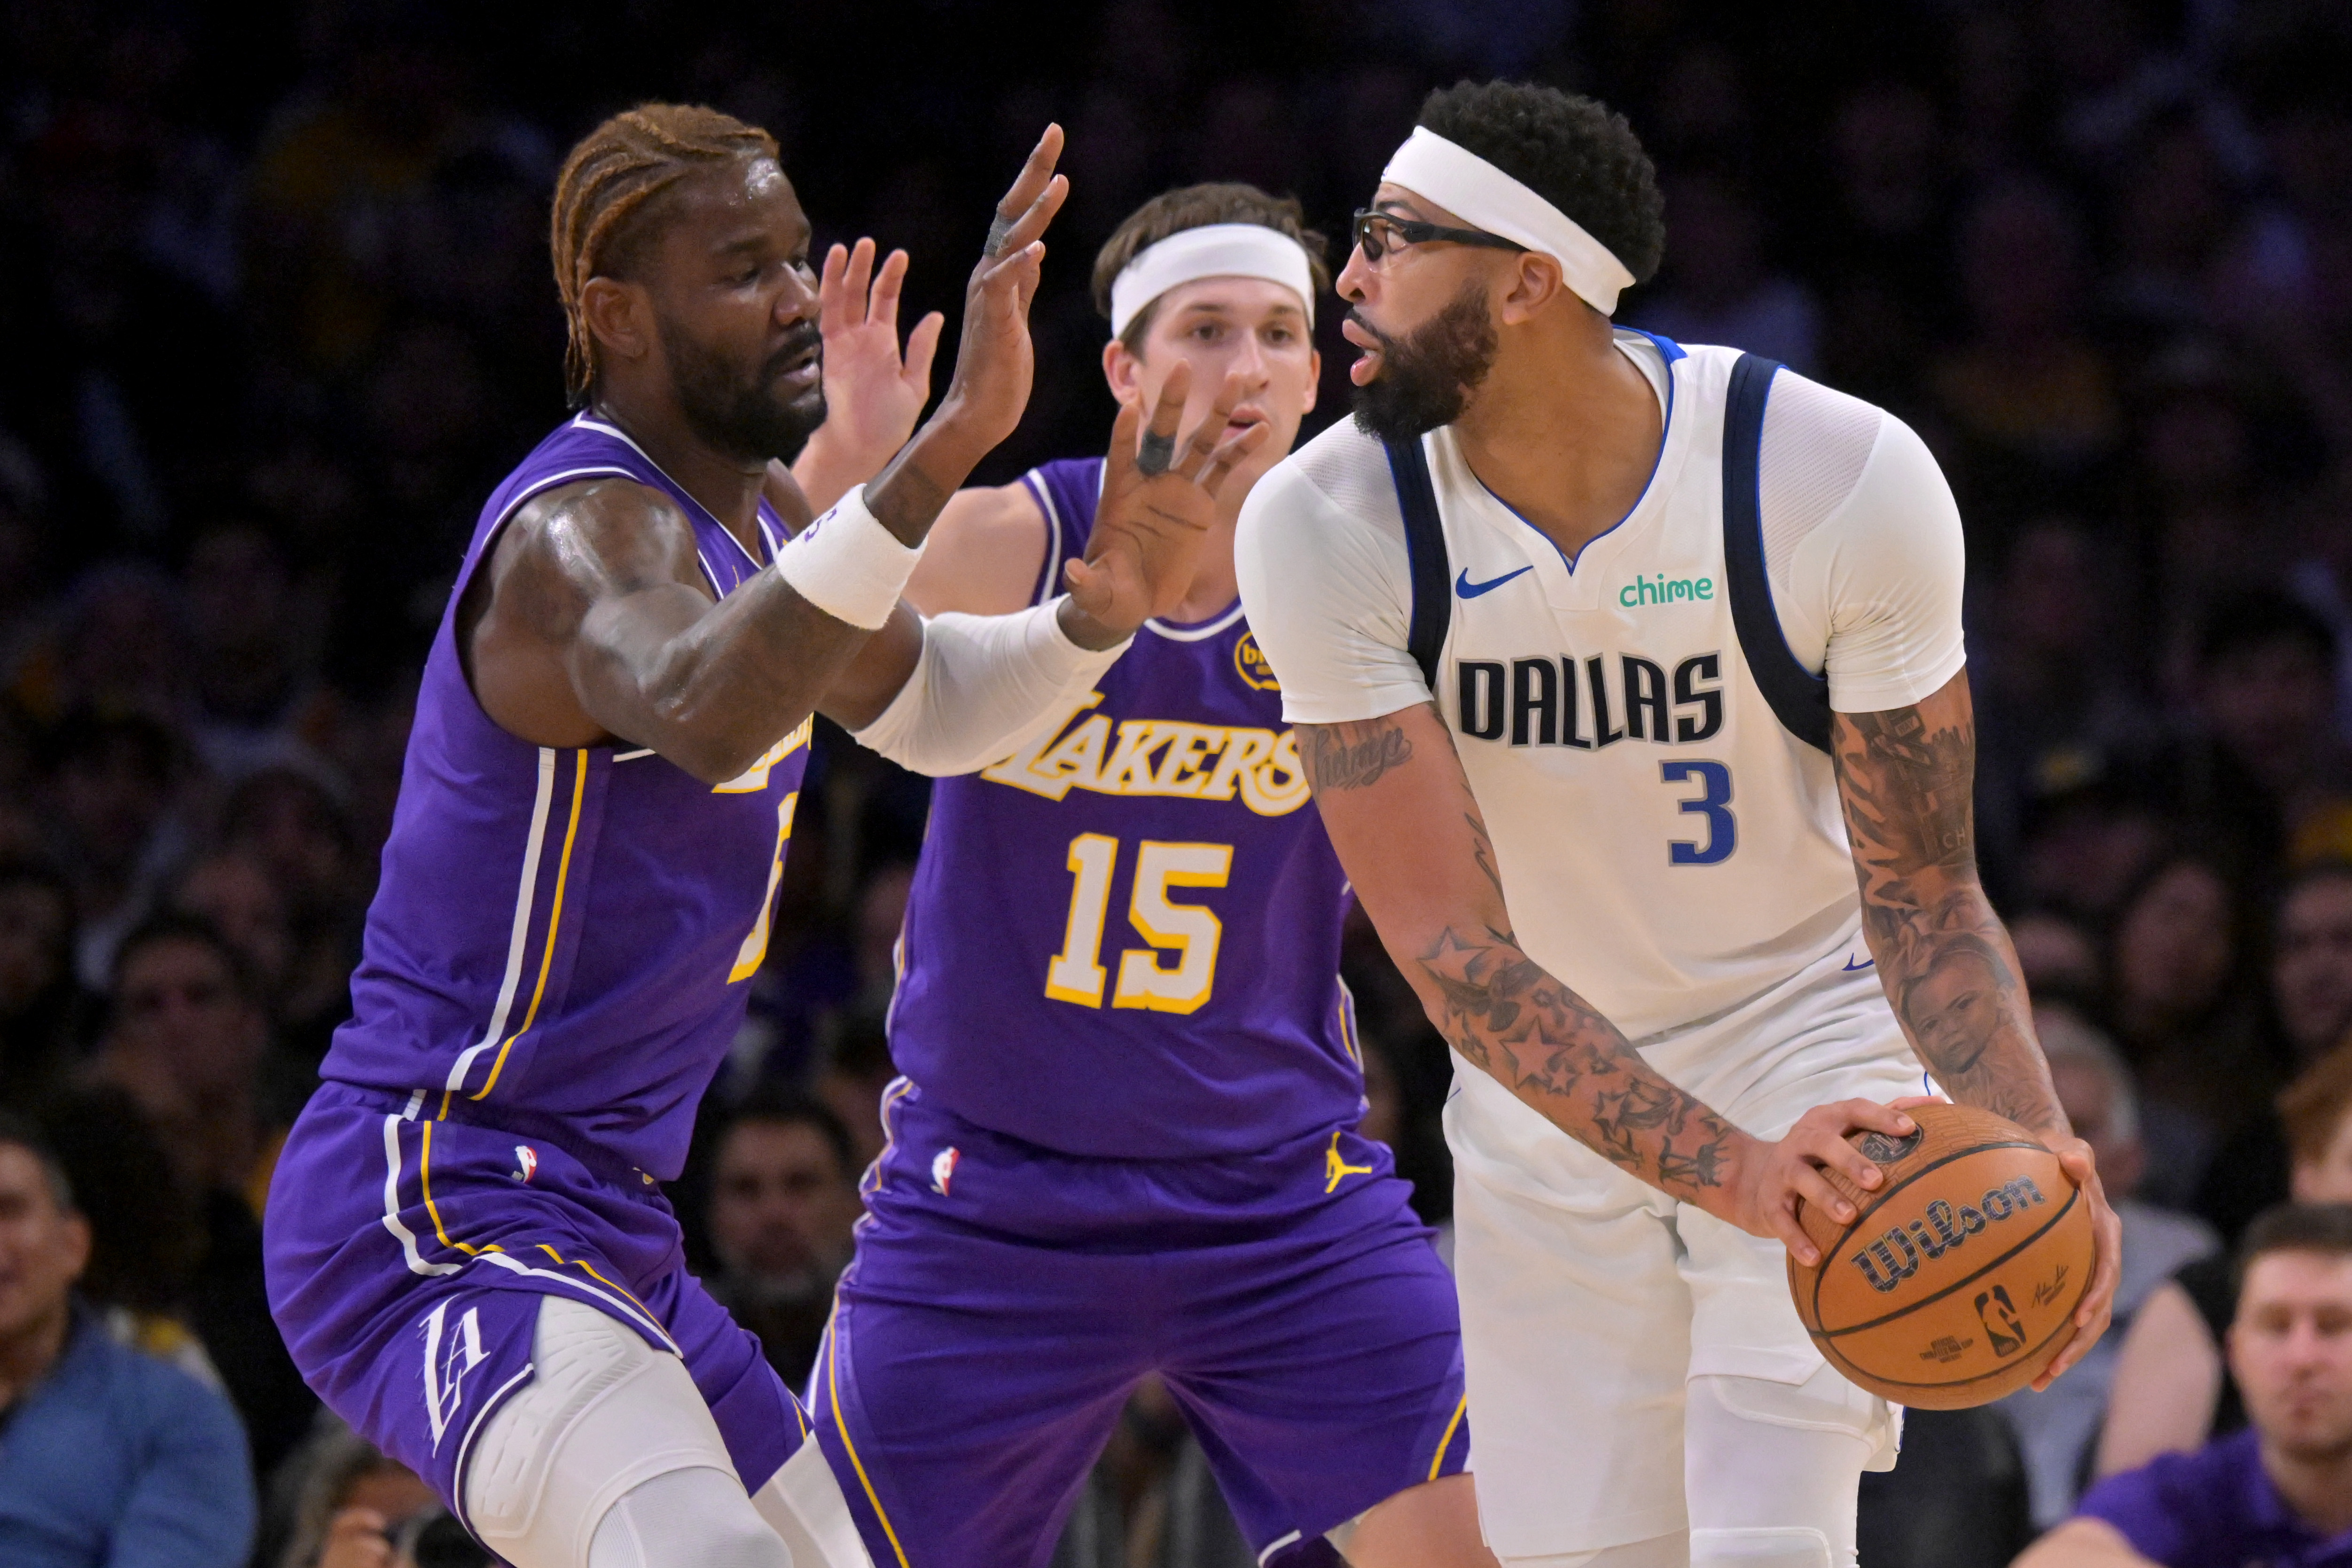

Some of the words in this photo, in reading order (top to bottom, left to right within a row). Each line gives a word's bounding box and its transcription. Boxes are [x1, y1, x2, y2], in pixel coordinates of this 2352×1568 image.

[1620, 573, 1713, 607] chime
[981, 691, 1313, 817] LAKERS
[1455, 650, 1723, 752] DALLAS
[1658, 758, 1739, 867] 3
[1045, 832, 1234, 1015] 15
[1850, 1174, 2046, 1295] Wilson
[419, 1293, 491, 1459] LA
